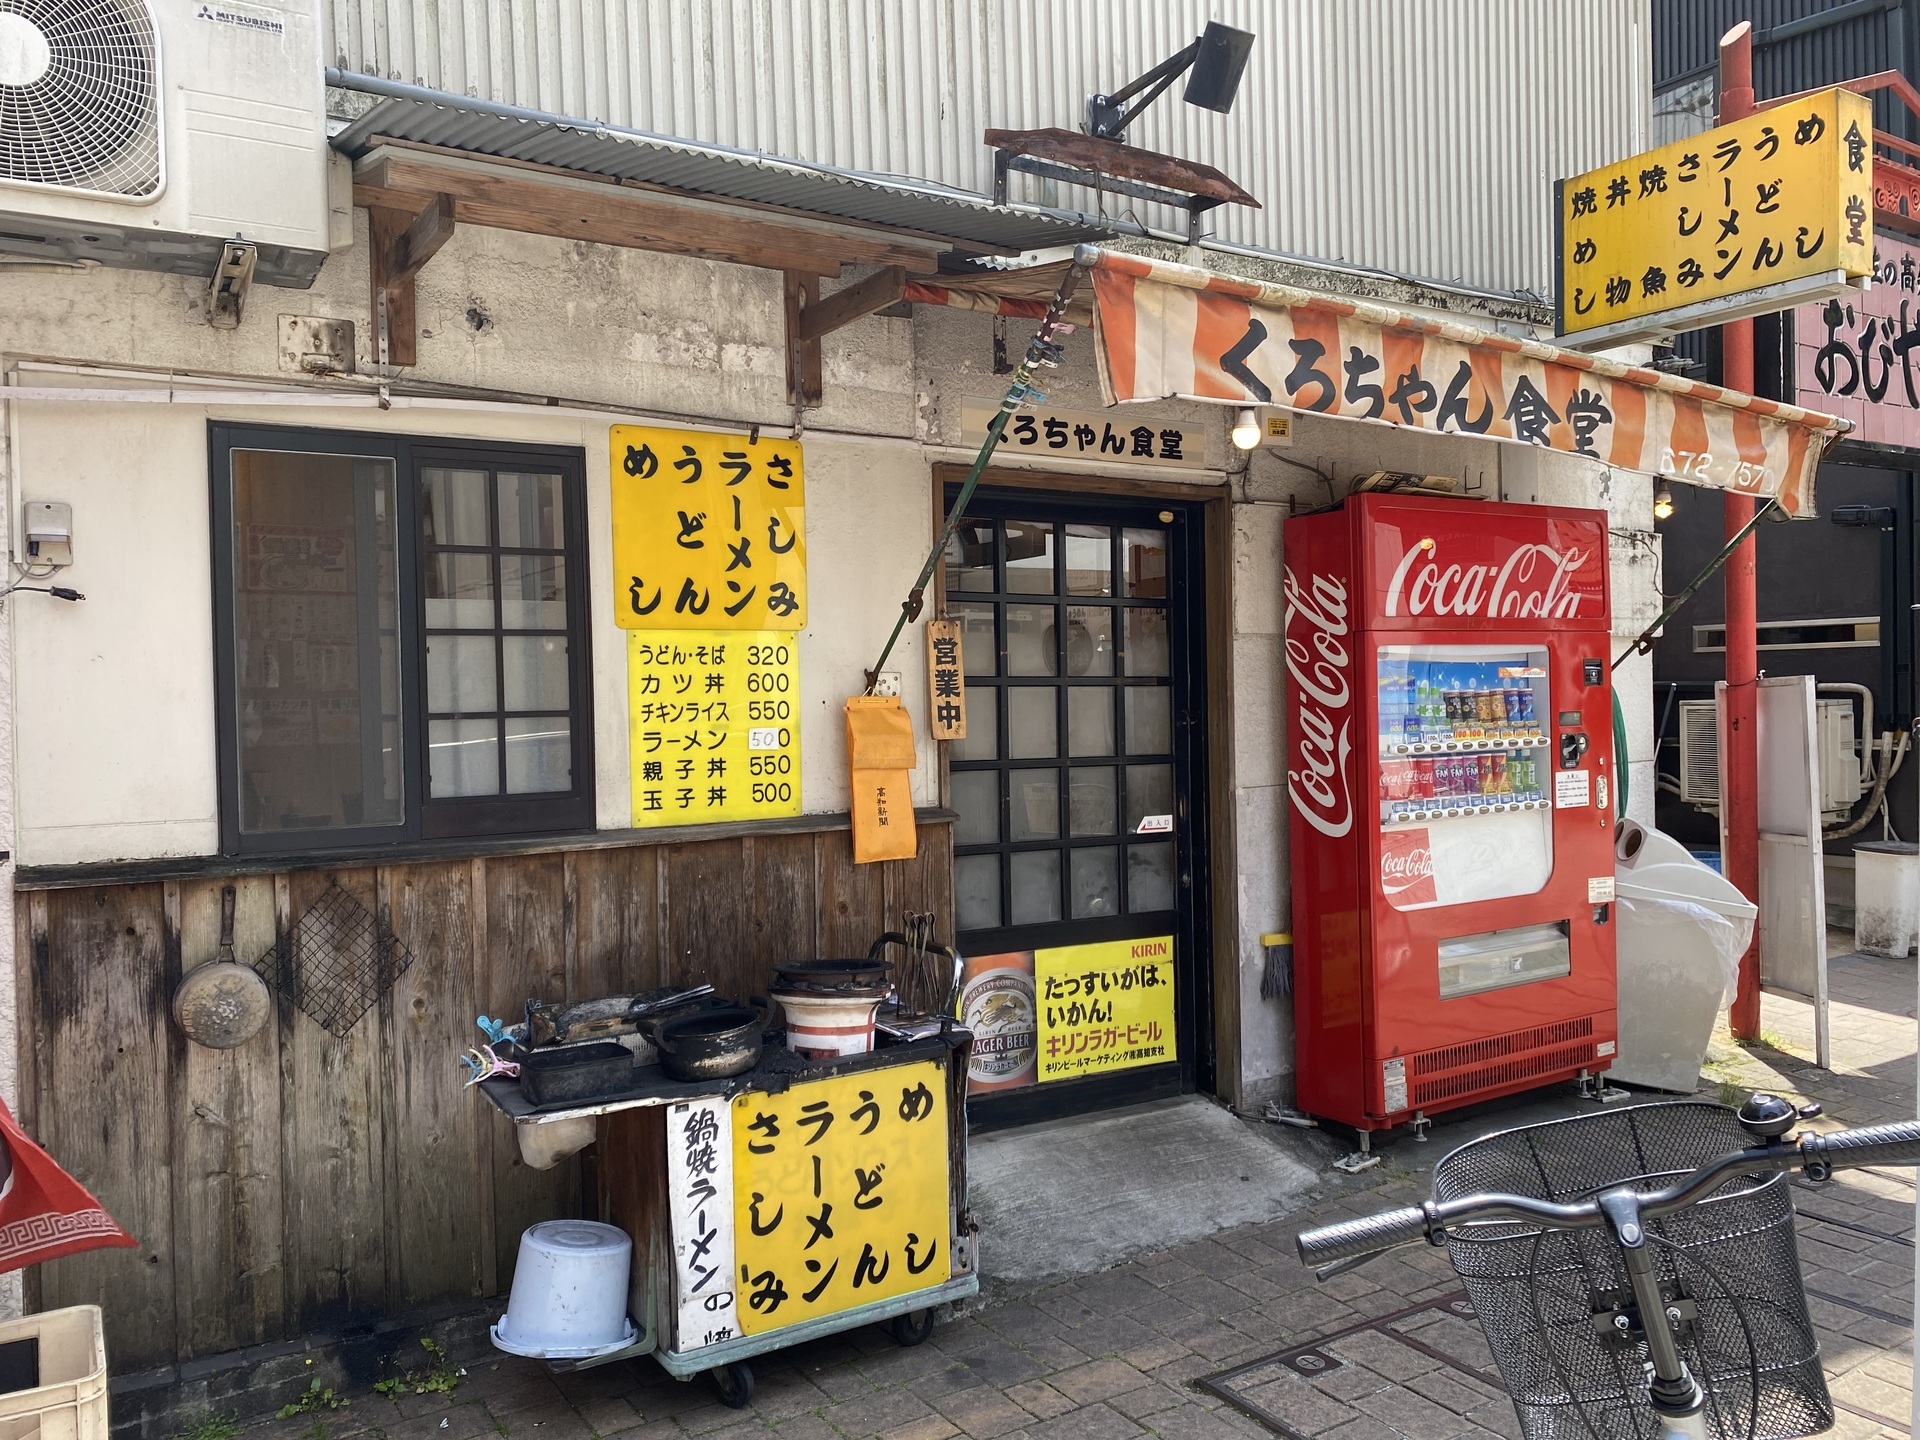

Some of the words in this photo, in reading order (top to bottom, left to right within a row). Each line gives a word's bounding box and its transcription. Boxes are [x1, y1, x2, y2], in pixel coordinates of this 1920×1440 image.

[216, 11, 283, 30] MITSUBISHI
[1605, 175, 1632, 308] 丼物
[1638, 164, 1668, 299] 焼魚
[1677, 152, 1705, 288] さしみ
[1712, 138, 1744, 281] ラーメン
[1752, 127, 1784, 271] うどん
[1794, 113, 1826, 259] めし
[1843, 118, 1868, 247] 食堂
[1571, 186, 1597, 316] 焼めし
[1219, 317, 1613, 459] くろちゃん食堂
[623, 443, 662, 616] めし
[673, 444, 710, 615] うどん
[718, 451, 757, 617] ラーメン
[766, 453, 800, 617] さしみ
[640, 702, 730, 724] チキンライス
[748, 700, 790, 721] 550
[747, 645, 790, 666] 320
[747, 672, 790, 693] 600
[933, 637, 962, 731] 営業中
[1284, 563, 1353, 838] Coca-Cola
[642, 730, 727, 753] ラーメン
[751, 728, 791, 748] 500
[749, 755, 791, 776] 550
[752, 782, 792, 803] 500
[1147, 819, 1170, 827] 出入口
[1381, 848, 1434, 877] Coca-Cola
[1044, 964, 1167, 1001] たっすいがは、
[1046, 998, 1113, 1029] いかん!
[1131, 942, 1167, 959] KIRIN
[1006, 1033, 1029, 1050] BEER
[1046, 1021, 1163, 1058] キリンラガービール
[747, 1111, 789, 1315] さしみ
[796, 1100, 840, 1303] ラーメン
[849, 1090, 890, 1289] うどん
[899, 1081, 937, 1275] めし
